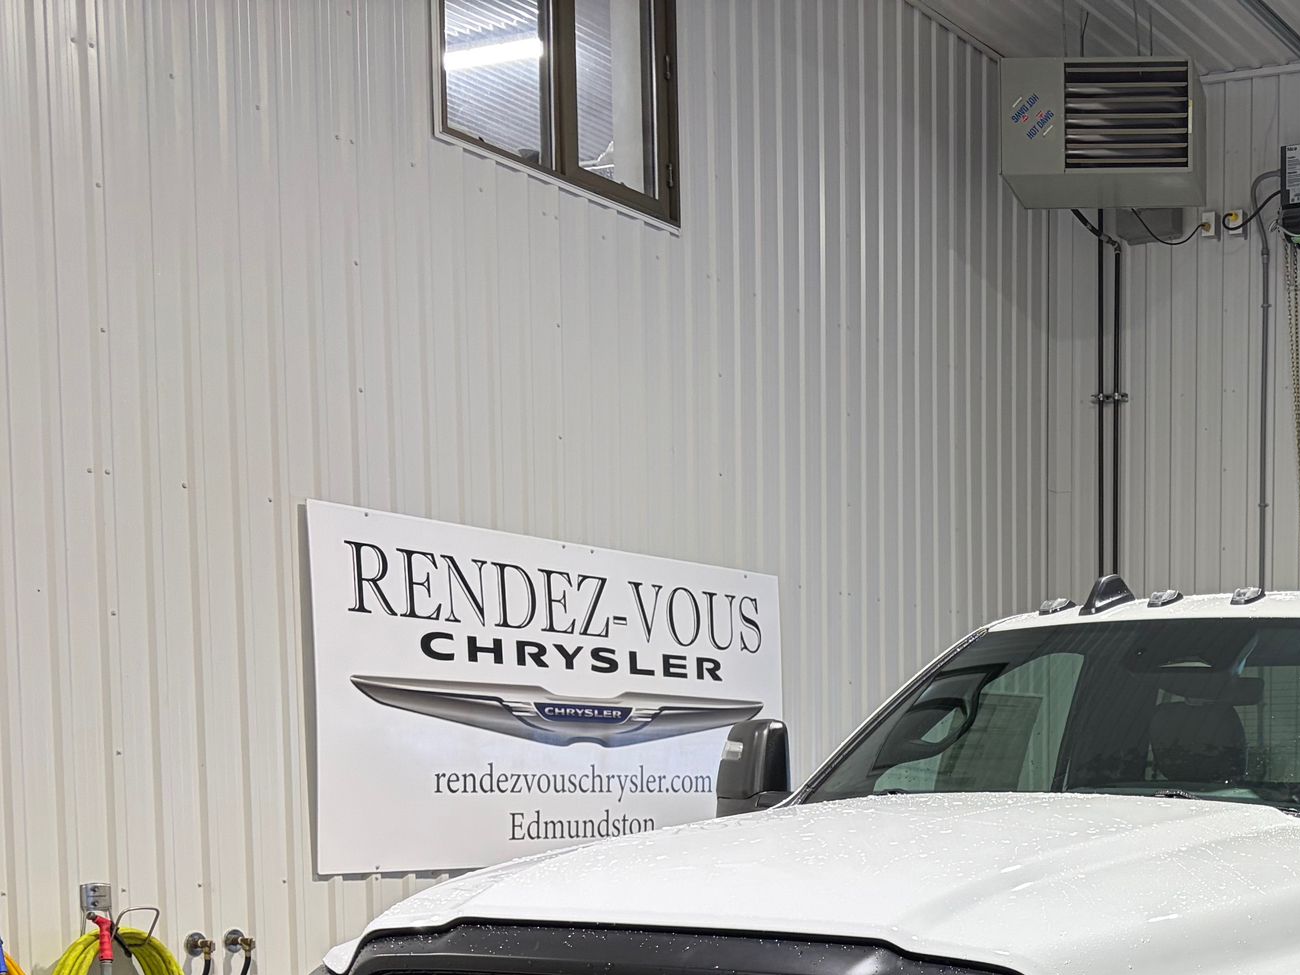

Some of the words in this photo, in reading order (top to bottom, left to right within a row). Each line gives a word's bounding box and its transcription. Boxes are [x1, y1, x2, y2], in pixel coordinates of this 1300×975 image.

[343, 539, 762, 654] RENDEZ-VOUS
[420, 631, 723, 682] CHRYSLER
[544, 705, 623, 719] CHRYSLER
[434, 762, 713, 803] rendezvouschrysler.com
[508, 809, 656, 841] Edmundston
